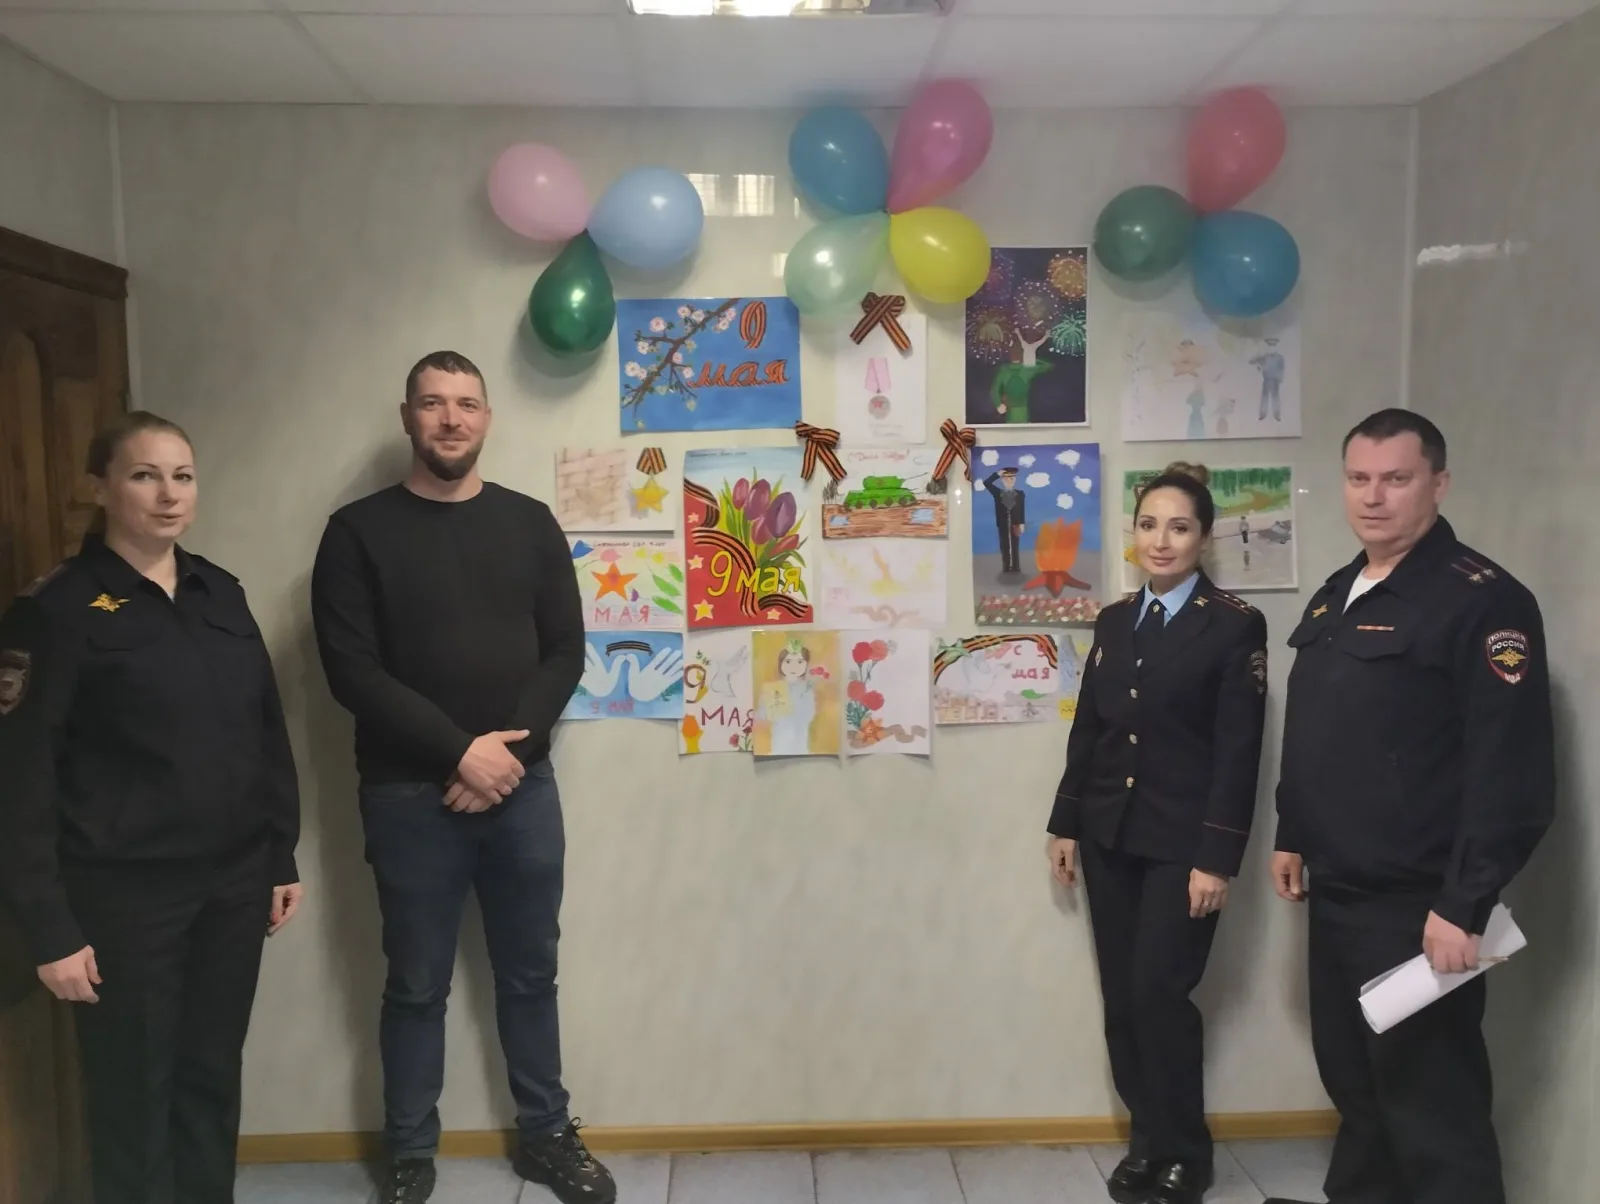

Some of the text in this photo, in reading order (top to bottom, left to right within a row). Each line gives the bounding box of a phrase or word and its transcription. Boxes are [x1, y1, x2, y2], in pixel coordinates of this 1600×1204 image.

[687, 358, 791, 389] мая
[707, 550, 734, 597] 9
[735, 566, 802, 594] мая
[594, 604, 651, 623] МАЯ
[1488, 631, 1526, 645] ПОЛИЦИЯ
[1491, 640, 1525, 652] РОССИЯ
[683, 663, 707, 704] 9
[1011, 667, 1050, 680] мая
[701, 705, 754, 728] МАЯ
